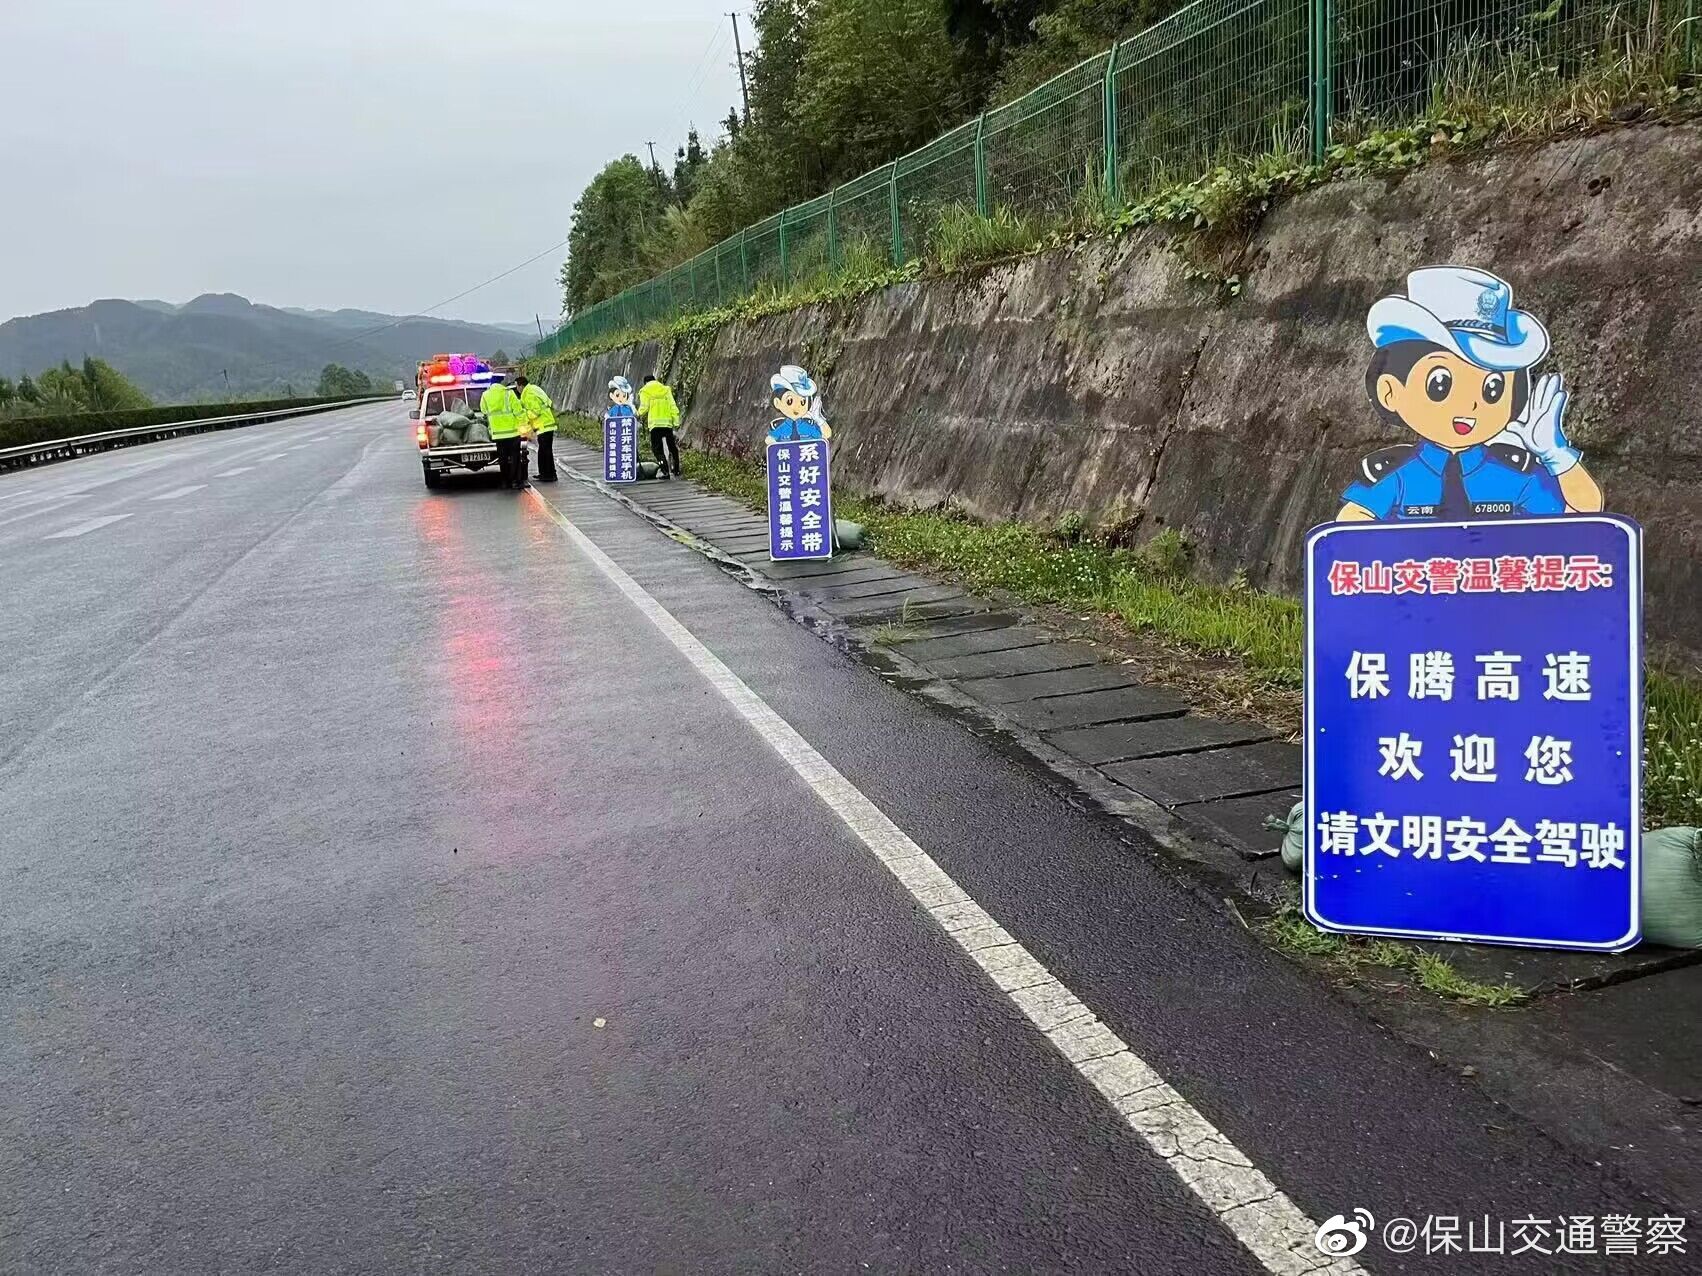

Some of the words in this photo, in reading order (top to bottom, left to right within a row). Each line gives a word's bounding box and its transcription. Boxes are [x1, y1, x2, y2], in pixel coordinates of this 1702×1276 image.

[777, 448, 794, 551] 保山交警温馨提示
[799, 443, 822, 552] 系好安全带
[1407, 506, 1434, 515] 云南
[1475, 504, 1510, 514] 678000
[1345, 650, 1592, 701] 保腾高速
[1378, 733, 1574, 785] 欢迎您
[1318, 811, 1626, 870] 请文明安全驾驶
